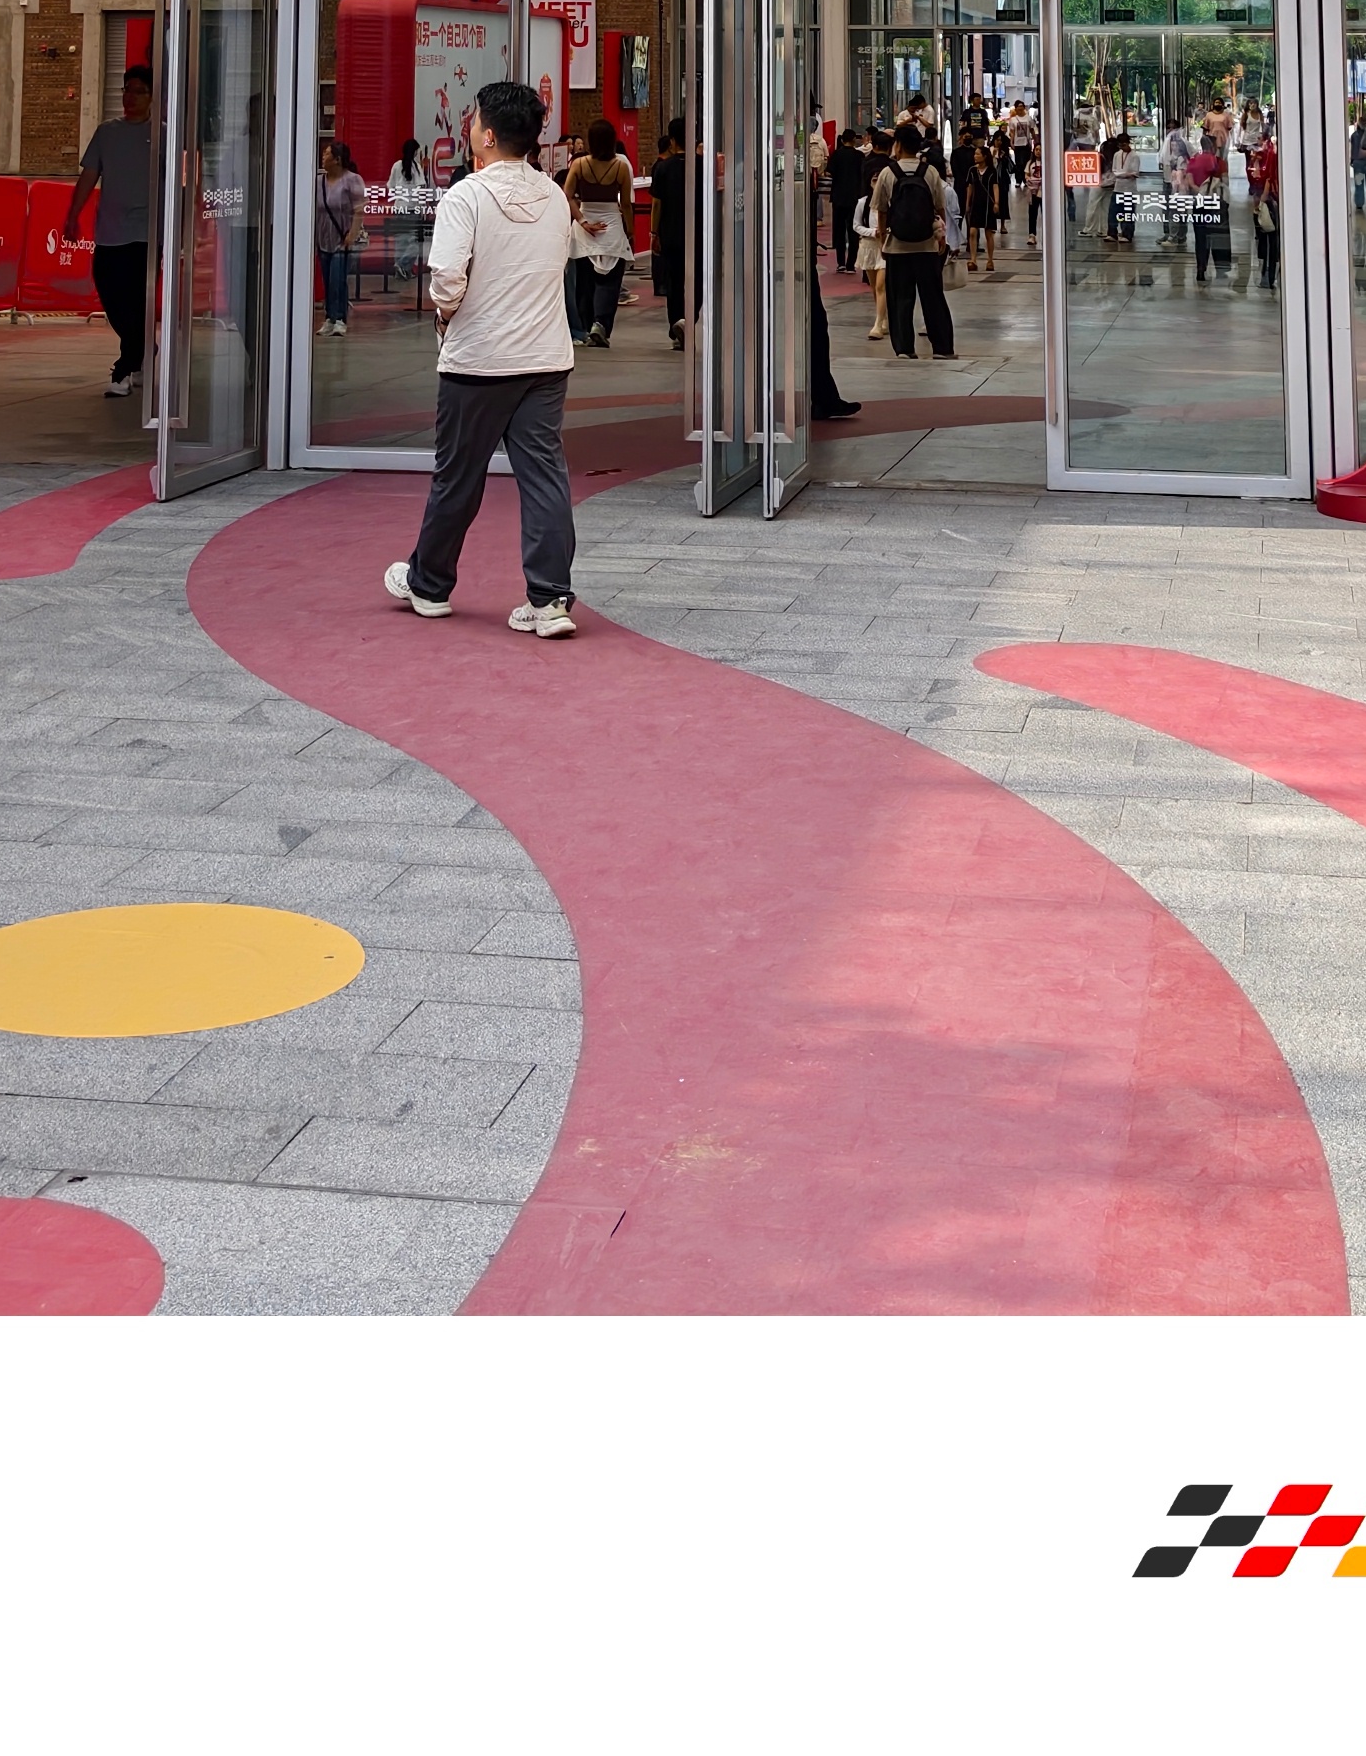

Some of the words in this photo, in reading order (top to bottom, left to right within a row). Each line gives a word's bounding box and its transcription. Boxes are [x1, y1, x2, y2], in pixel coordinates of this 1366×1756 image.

[1081, 157, 1096, 171] 拉
[1067, 174, 1099, 184] PULL
[1115, 191, 1221, 211] 中央车站
[202, 208, 224, 219] CENTRAL
[363, 205, 411, 215] CENTRAL
[1115, 212, 1169, 223] CENTRAL
[1172, 213, 1221, 224] STATION
